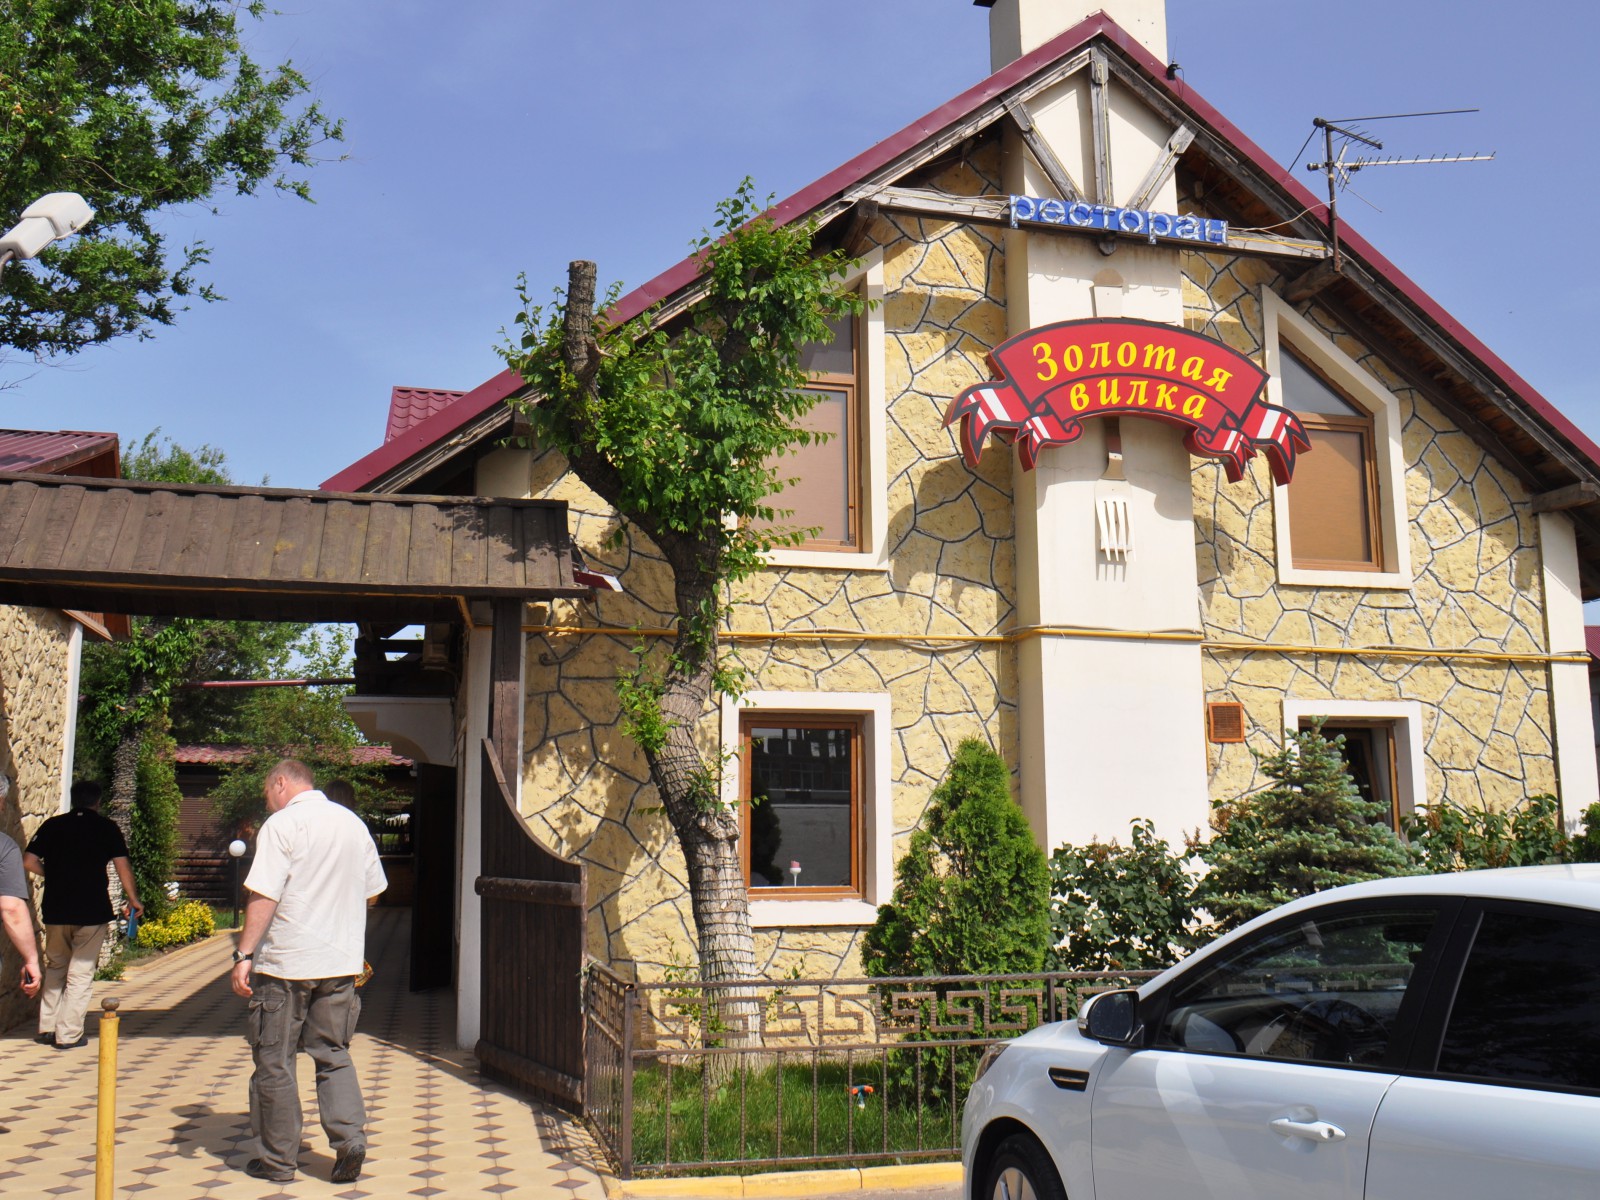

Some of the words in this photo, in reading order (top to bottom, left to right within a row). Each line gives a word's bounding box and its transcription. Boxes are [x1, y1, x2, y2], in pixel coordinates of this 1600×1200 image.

[1010, 195, 1228, 244] ресторан
[1032, 341, 1233, 393] Золотая
[1069, 377, 1206, 419] вилка
